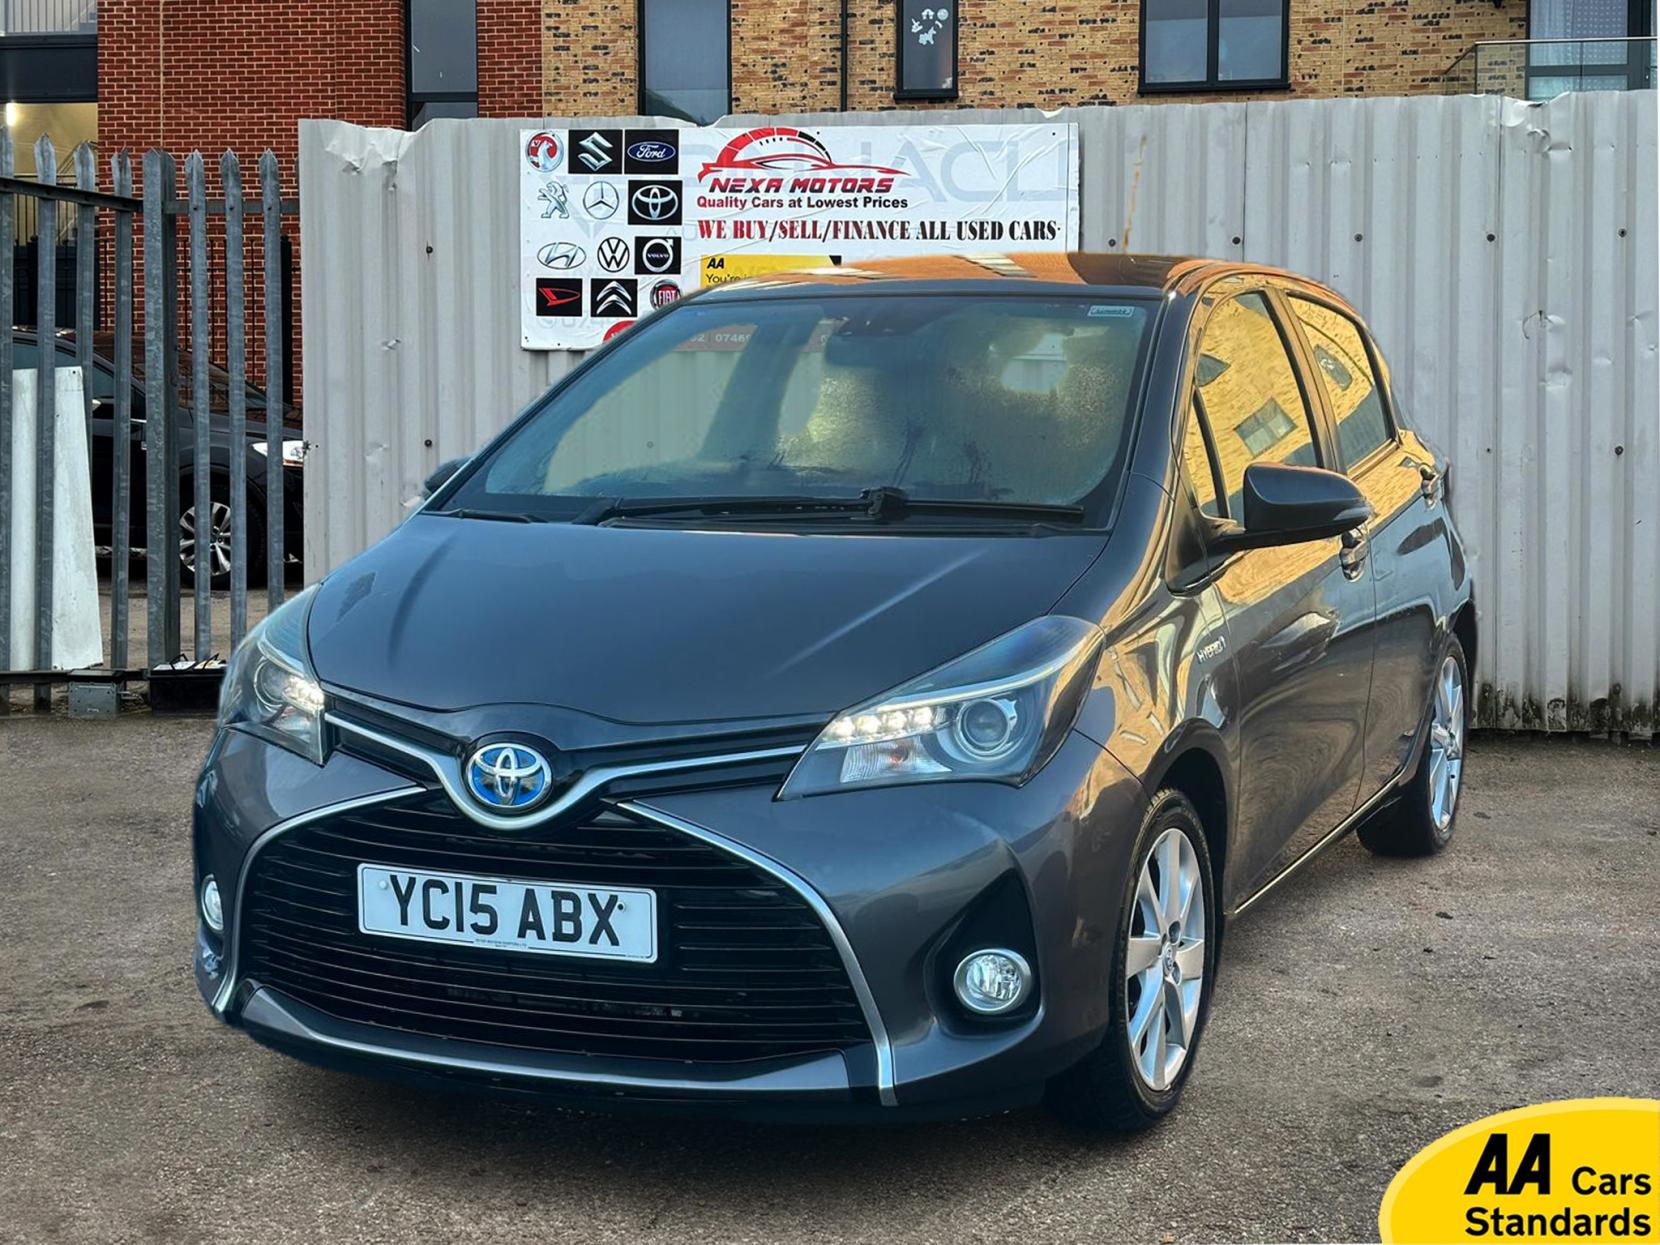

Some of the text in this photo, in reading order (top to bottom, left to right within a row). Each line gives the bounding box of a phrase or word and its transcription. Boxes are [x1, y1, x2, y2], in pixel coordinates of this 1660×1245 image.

[636, 144, 666, 159] Ford
[709, 178, 894, 193] NEXA MOTORS
[697, 196, 908, 210] Quality Cars at Lowest Prices
[697, 220, 727, 240] WE
[732, 219, 911, 242] BUY/SELL/FINANCE
[916, 220, 951, 240] ALL
[956, 220, 1004, 240] USED
[1008, 220, 1057, 240] CARS
[706, 257, 725, 270] AA
[658, 289, 676, 305] FIAT
[389, 874, 620, 947] YC15 ABX
